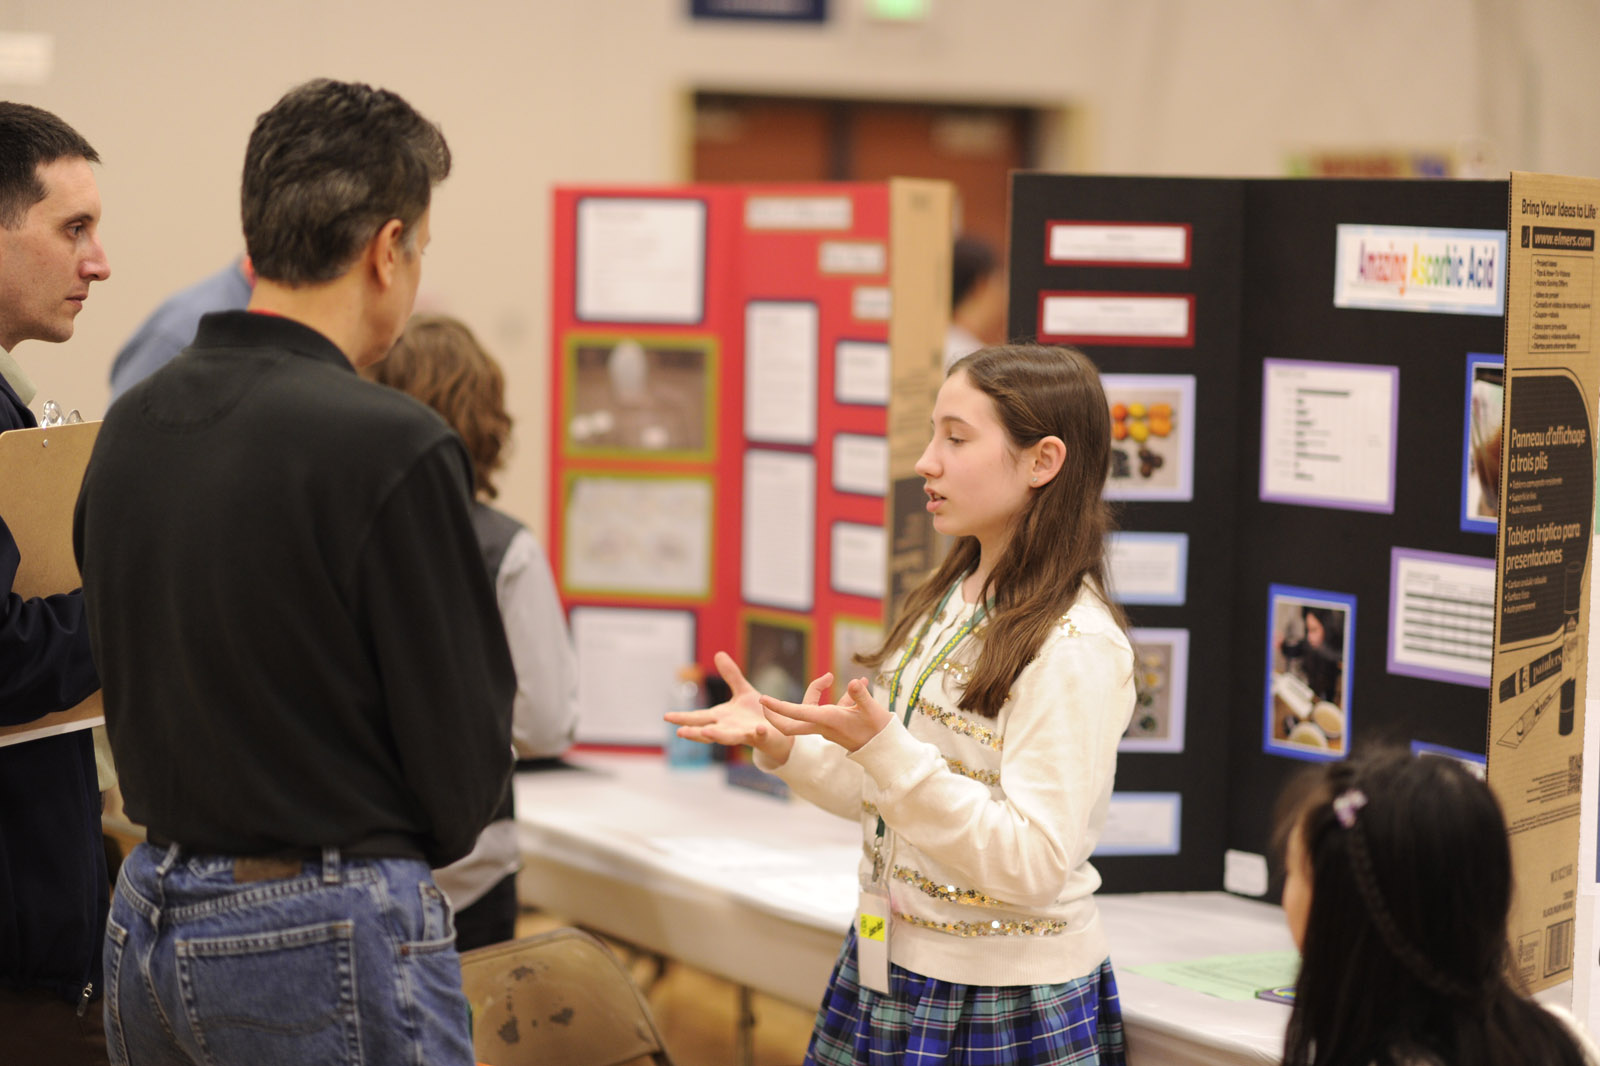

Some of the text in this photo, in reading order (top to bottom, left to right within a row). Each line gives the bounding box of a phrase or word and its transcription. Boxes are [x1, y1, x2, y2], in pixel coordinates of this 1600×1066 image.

[1522, 198, 1539, 218] Bring
[1541, 200, 1557, 216] Your
[1558, 201, 1576, 217] Ideas
[1577, 203, 1583, 218] to
[1534, 231, 1592, 248] www.elmers.com
[1358, 240, 1496, 296] Amazing Ascorbic Acid
[1511, 425, 1586, 448] Panneau d'affichage
[1517, 452, 1534, 472] trois
[1534, 450, 1549, 475] plis
[1507, 525, 1536, 546] Tablero
[1562, 523, 1581, 543] para
[1505, 546, 1563, 575] presentaciones
